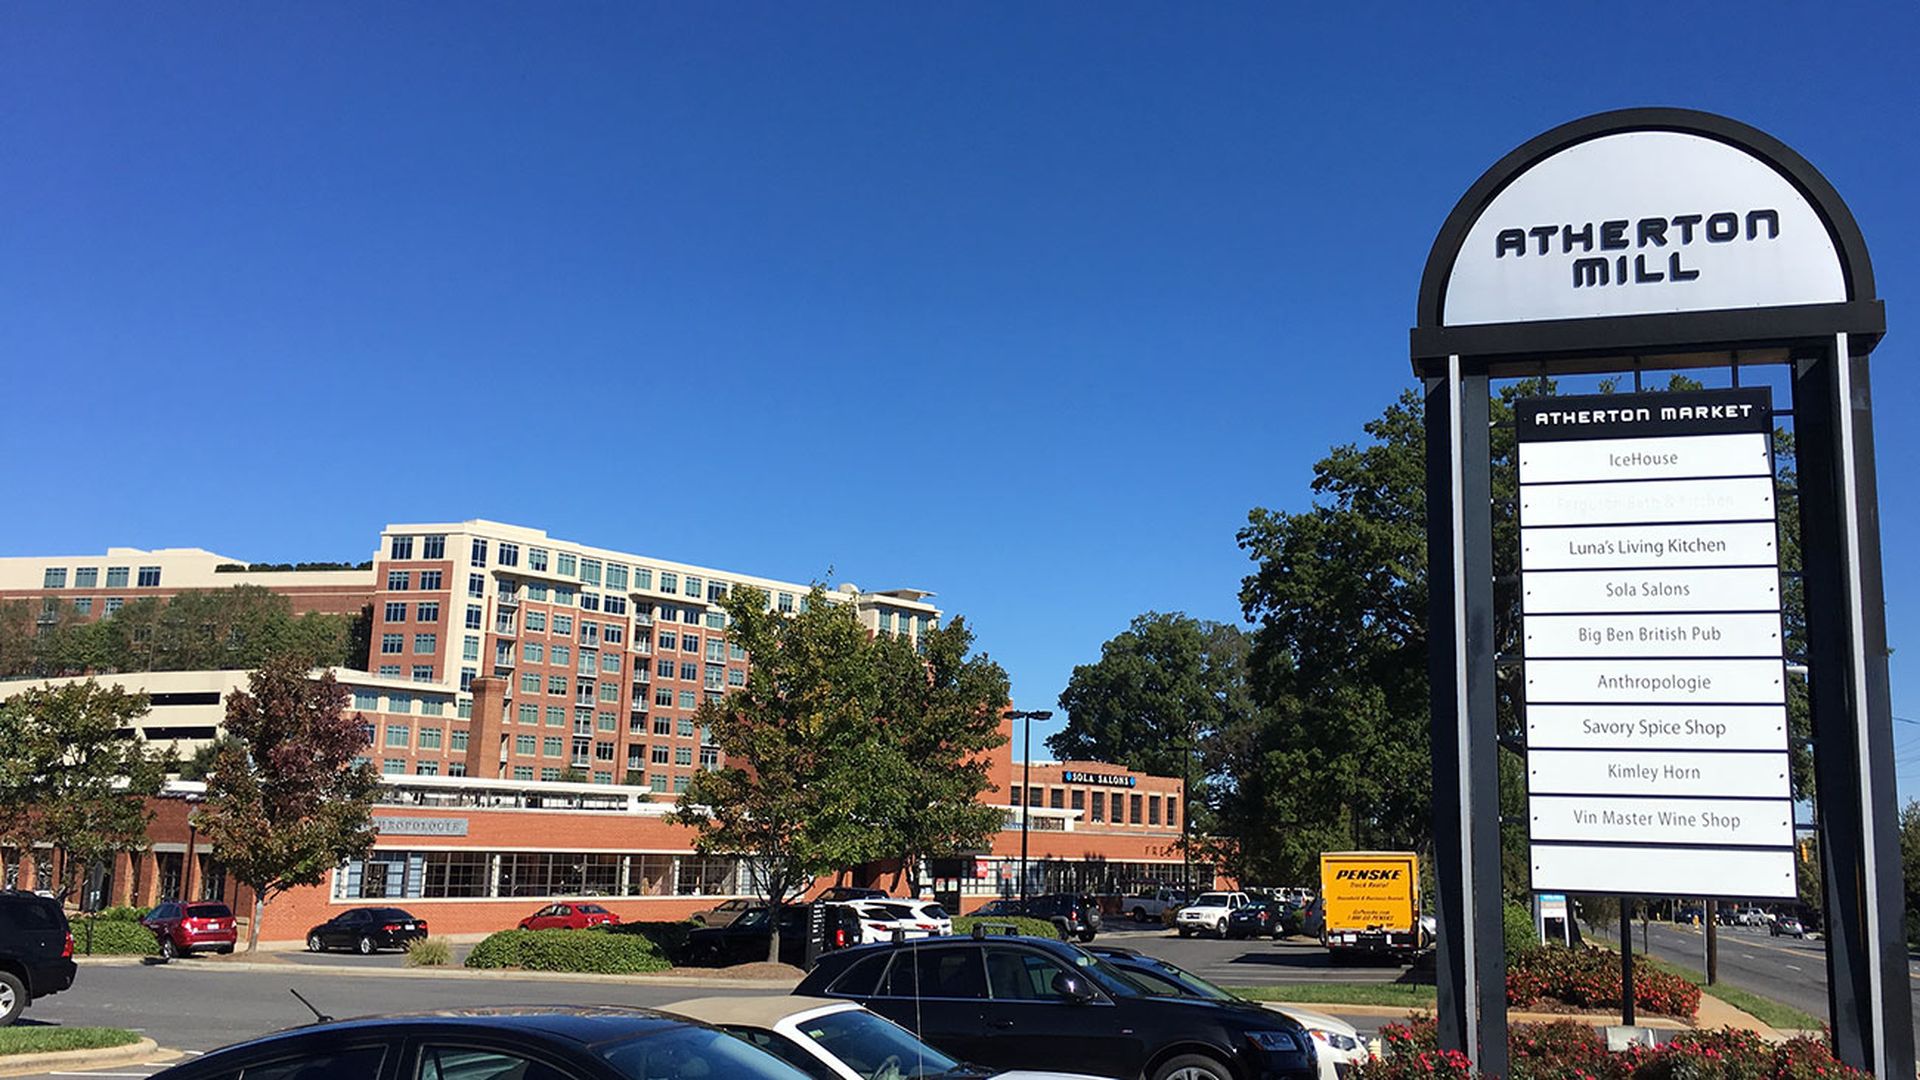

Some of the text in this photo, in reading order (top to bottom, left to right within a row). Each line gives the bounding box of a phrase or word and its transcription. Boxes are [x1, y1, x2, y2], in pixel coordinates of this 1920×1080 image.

[1496, 209, 1780, 258] ATHERTON
[1573, 252, 1701, 288] MILL
[1535, 404, 1753, 425] ATHERTON MARKET
[1609, 452, 1679, 468] IceHouse
[1569, 537, 1726, 558] Luna's Living Kitchen
[1605, 581, 1691, 598] Sola Salons
[1578, 625, 1722, 646] Big Ben British Pub
[1597, 673, 1712, 694] Anthropologie
[1582, 718, 1727, 739] Savory Spice Shop
[1072, 772, 1129, 786] SOLA SALONS
[1607, 763, 1701, 783] Kimley Horn
[1573, 809, 1741, 832] Vin Master Wine Shop
[1336, 869, 1403, 880] PENSKE
